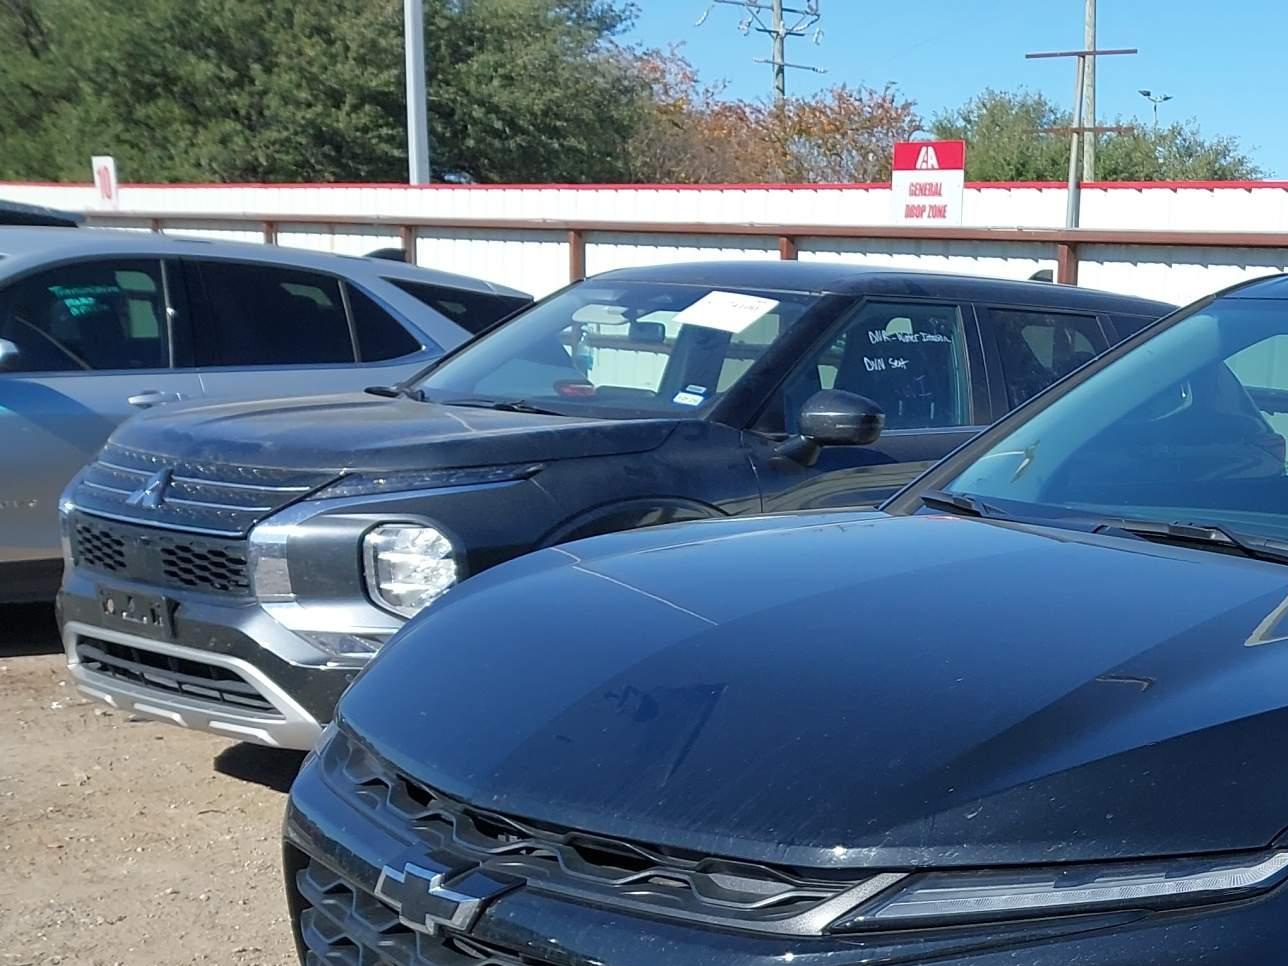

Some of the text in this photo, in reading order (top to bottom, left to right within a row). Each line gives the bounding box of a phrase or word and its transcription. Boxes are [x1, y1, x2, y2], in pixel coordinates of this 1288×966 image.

[908, 182, 943, 197] GENERAL
[904, 204, 948, 219] DROP ZONE
